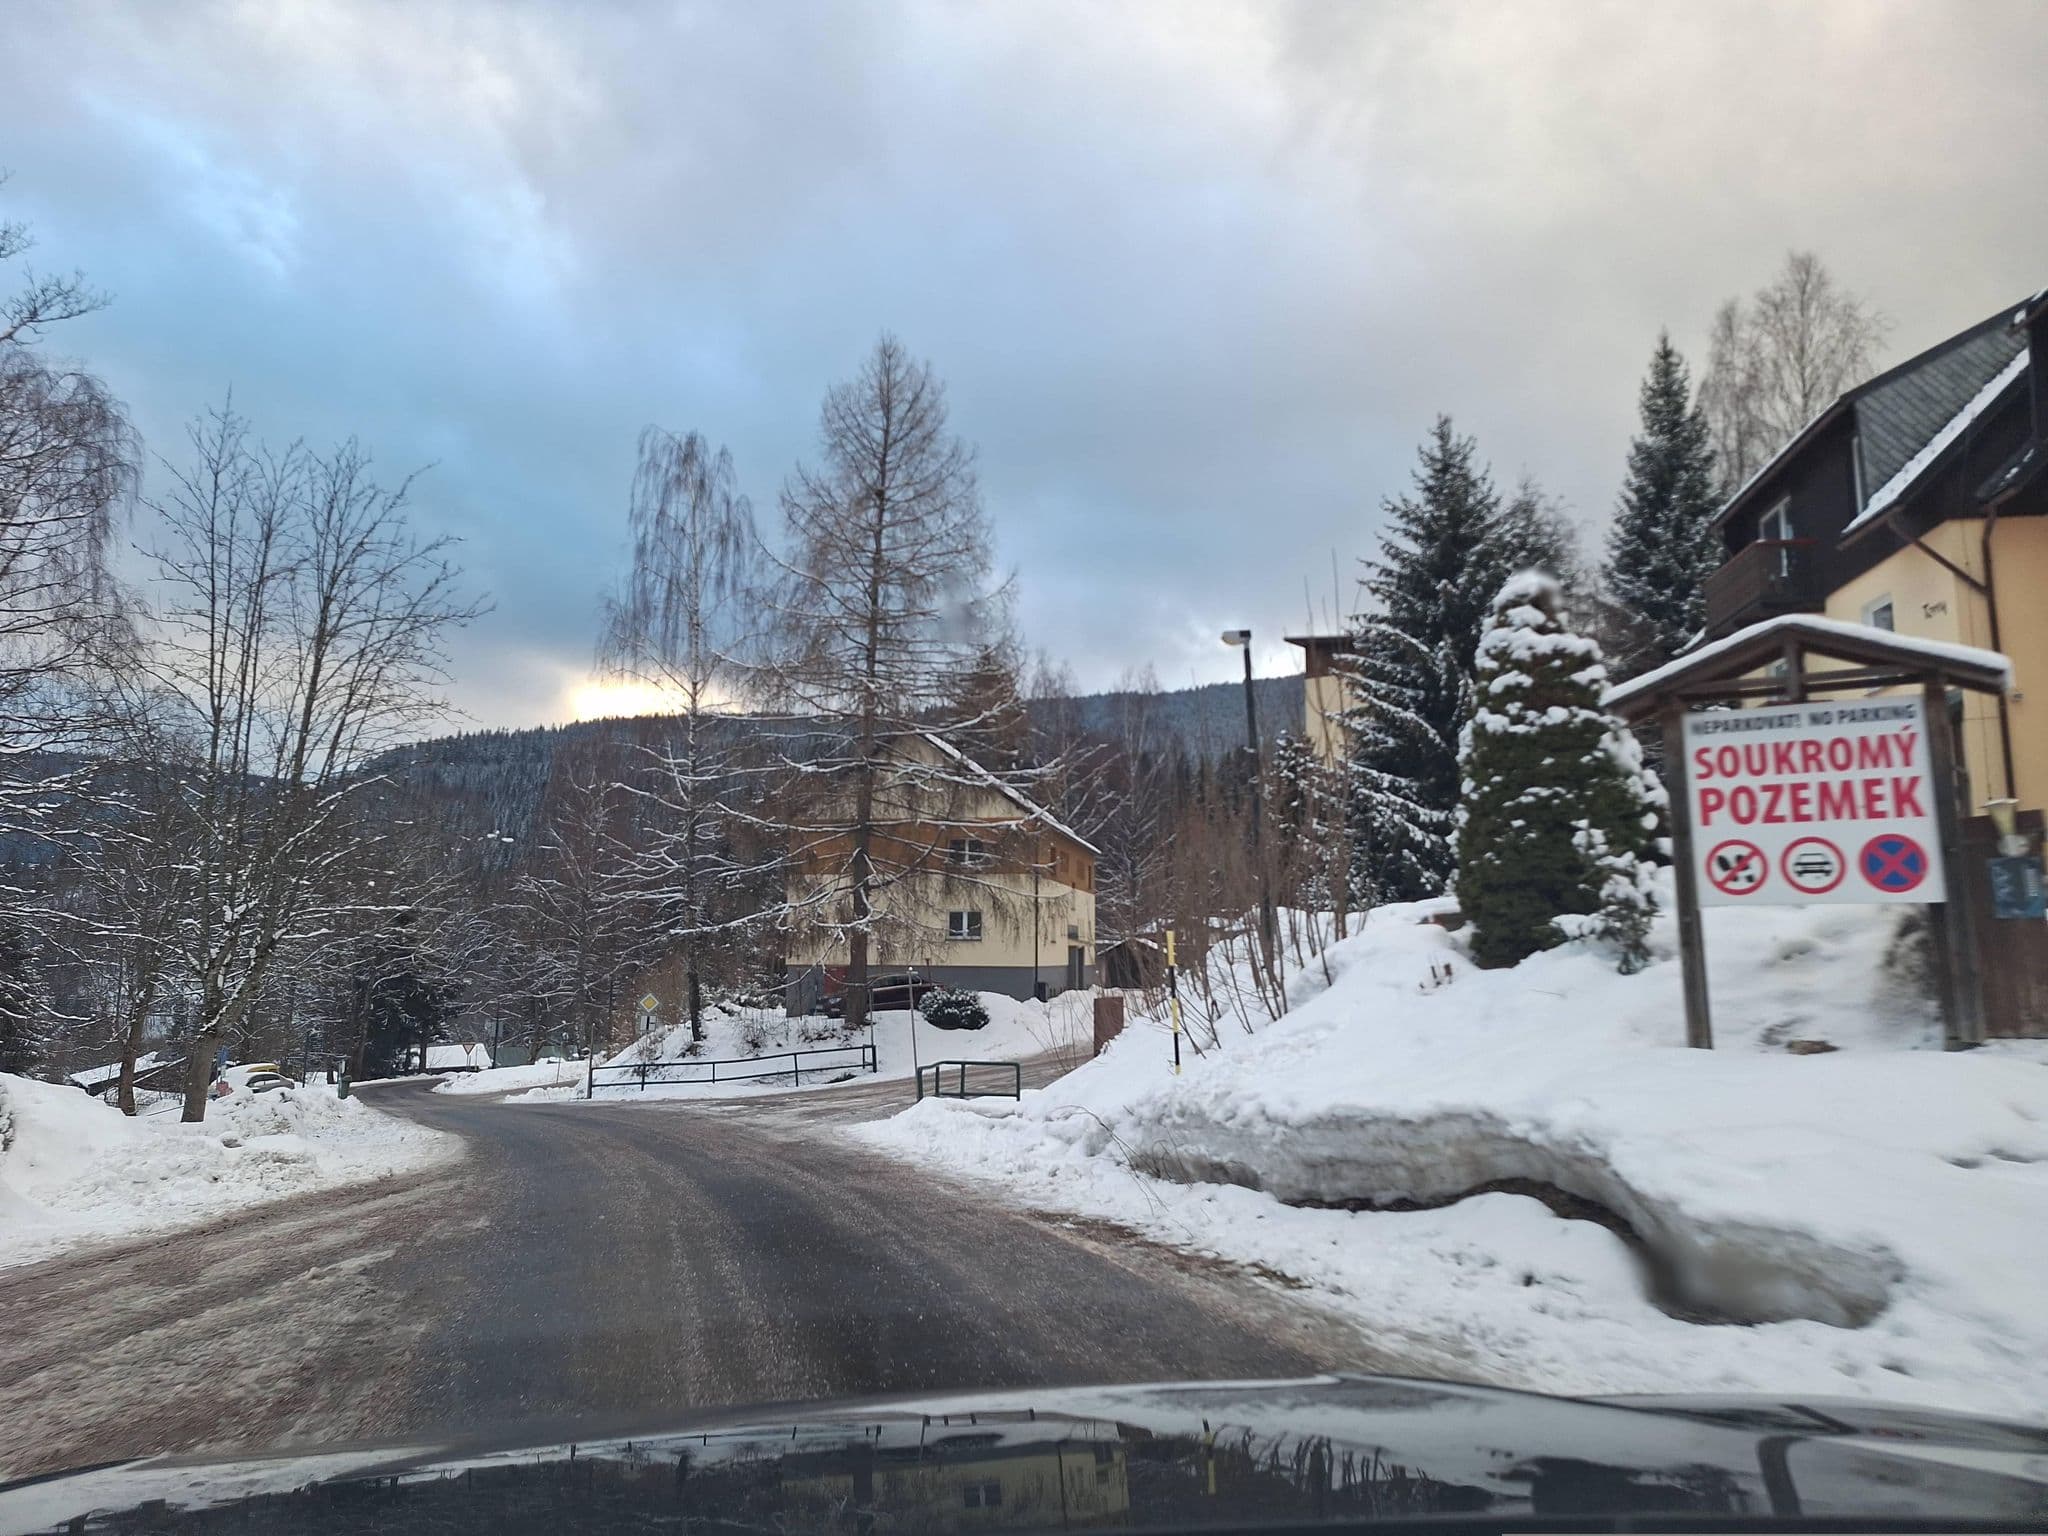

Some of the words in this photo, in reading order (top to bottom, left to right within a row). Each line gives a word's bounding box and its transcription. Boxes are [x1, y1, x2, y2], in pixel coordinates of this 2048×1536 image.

[1808, 711, 1834, 726] NO
[1837, 704, 1917, 724] PARKING
[1694, 725, 1918, 779] SOUKROMÝ
[1699, 776, 1926, 826] POZEMEK
